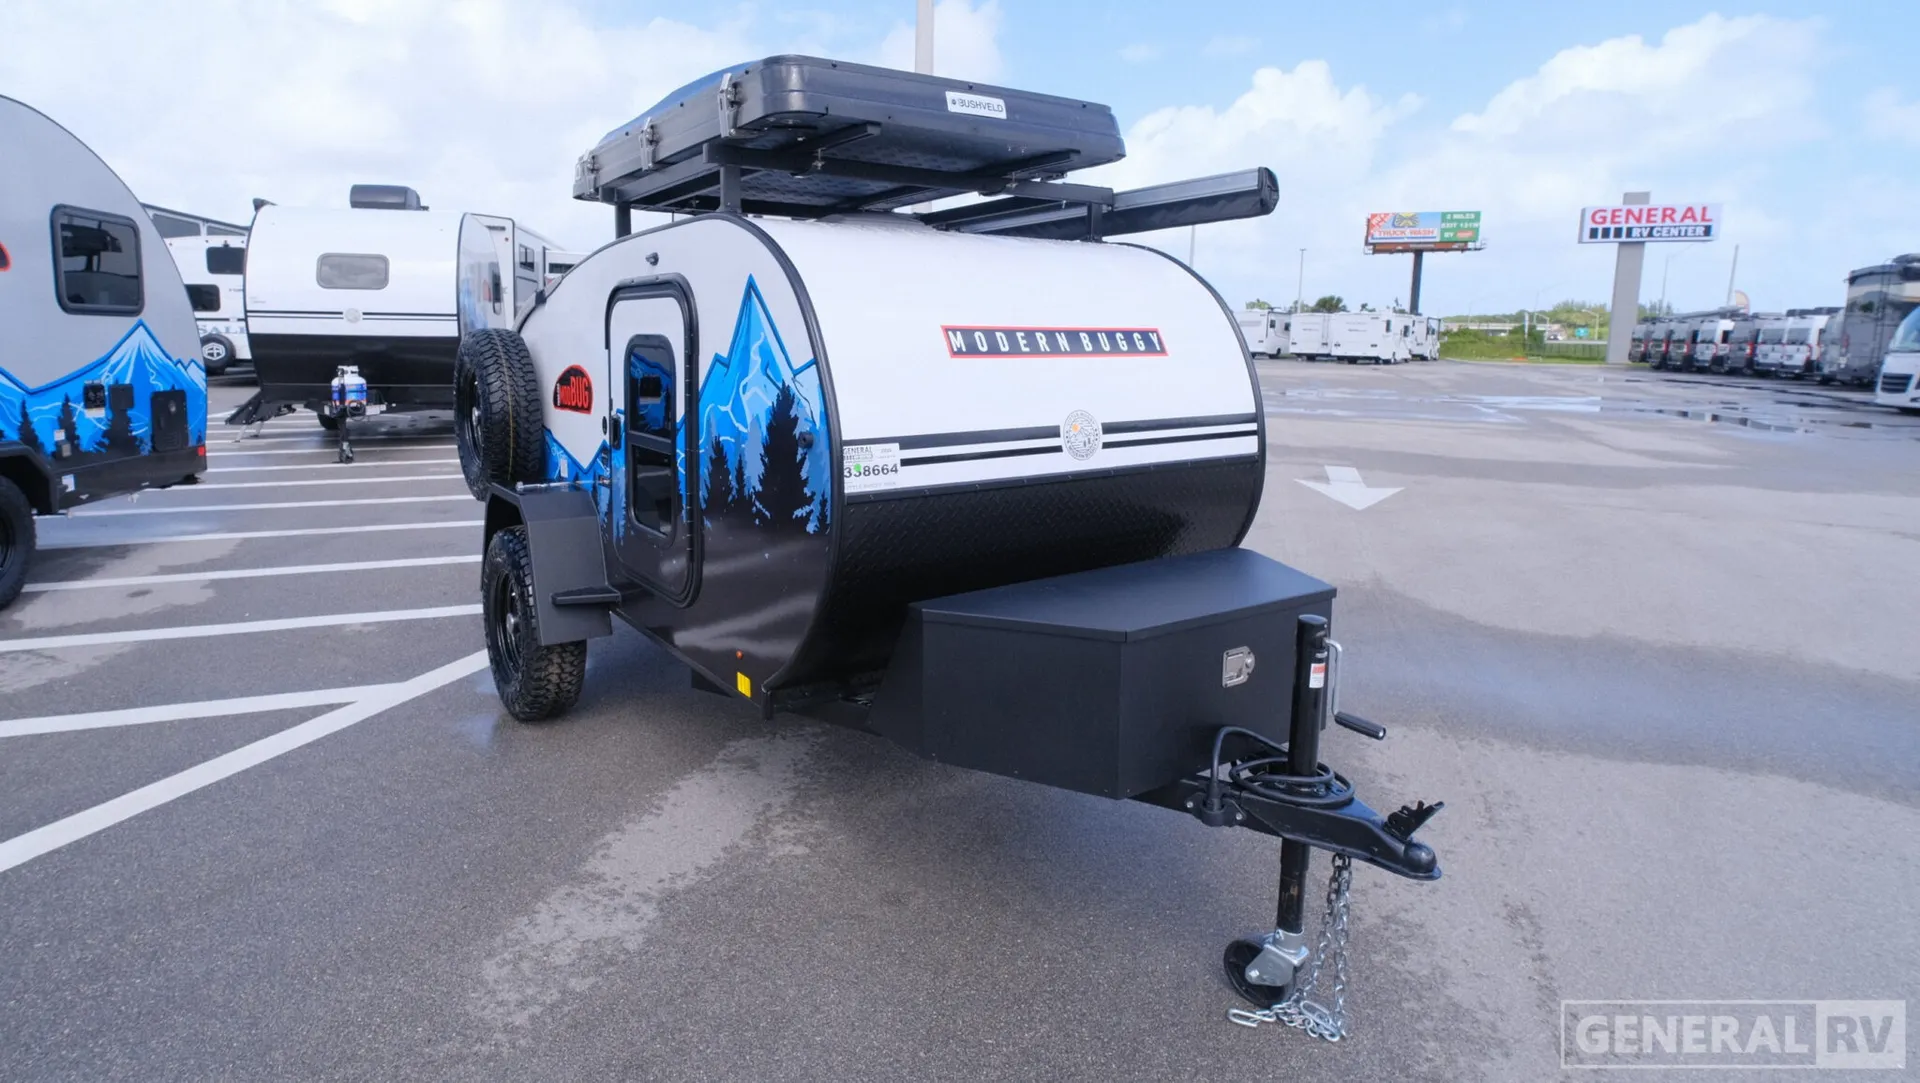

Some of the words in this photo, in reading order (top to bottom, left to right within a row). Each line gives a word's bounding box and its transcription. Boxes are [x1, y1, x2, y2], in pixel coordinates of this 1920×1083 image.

[958, 98, 1004, 113] BUSHVELD
[1590, 206, 1713, 225] GENERAL
[1377, 229, 1407, 237] TRUCK
[1409, 228, 1435, 237] WASH
[1631, 226, 1651, 238] RV
[1652, 226, 1706, 238] CENTER
[947, 330, 1072, 353] MODERN
[1079, 331, 1162, 353] BUGGY
